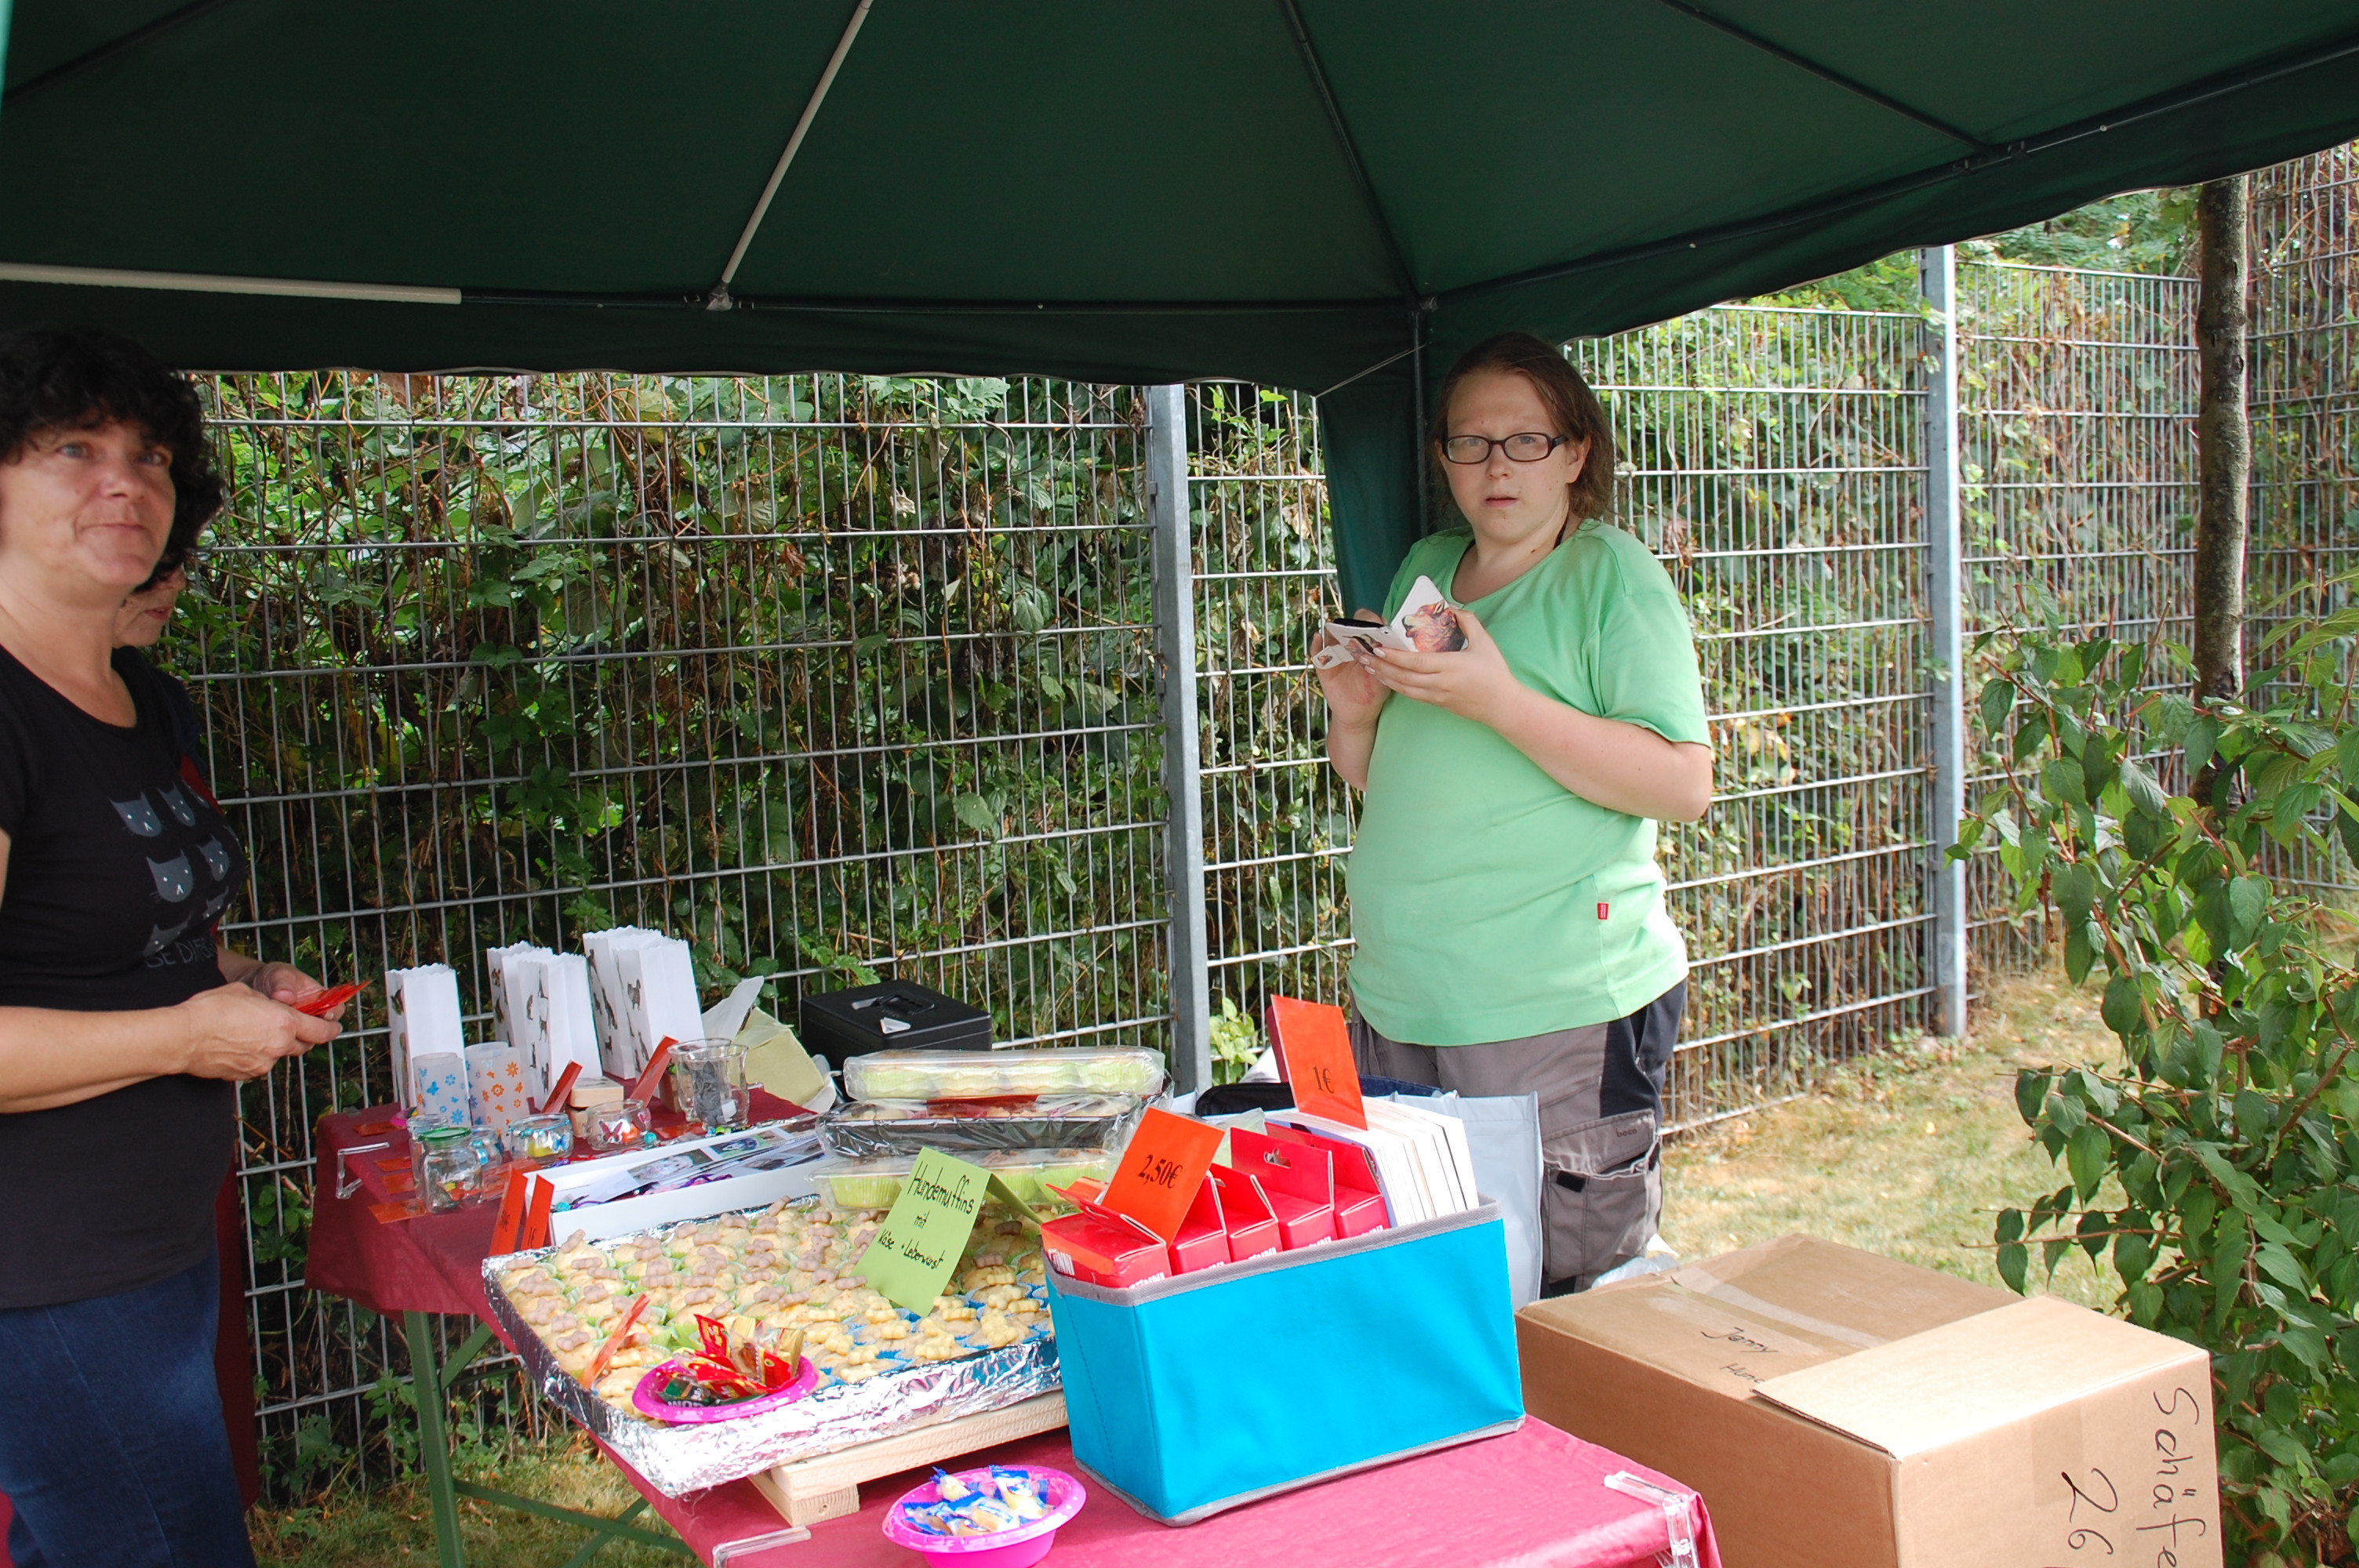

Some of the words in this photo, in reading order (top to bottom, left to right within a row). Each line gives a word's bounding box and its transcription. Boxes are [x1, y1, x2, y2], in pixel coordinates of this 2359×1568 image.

[1311, 1065, 1335, 1094] 1€
[907, 1160, 975, 1214] Hundemuffins
[1137, 1153, 1183, 1189] 2,50€
[913, 1210, 931, 1229] mit
